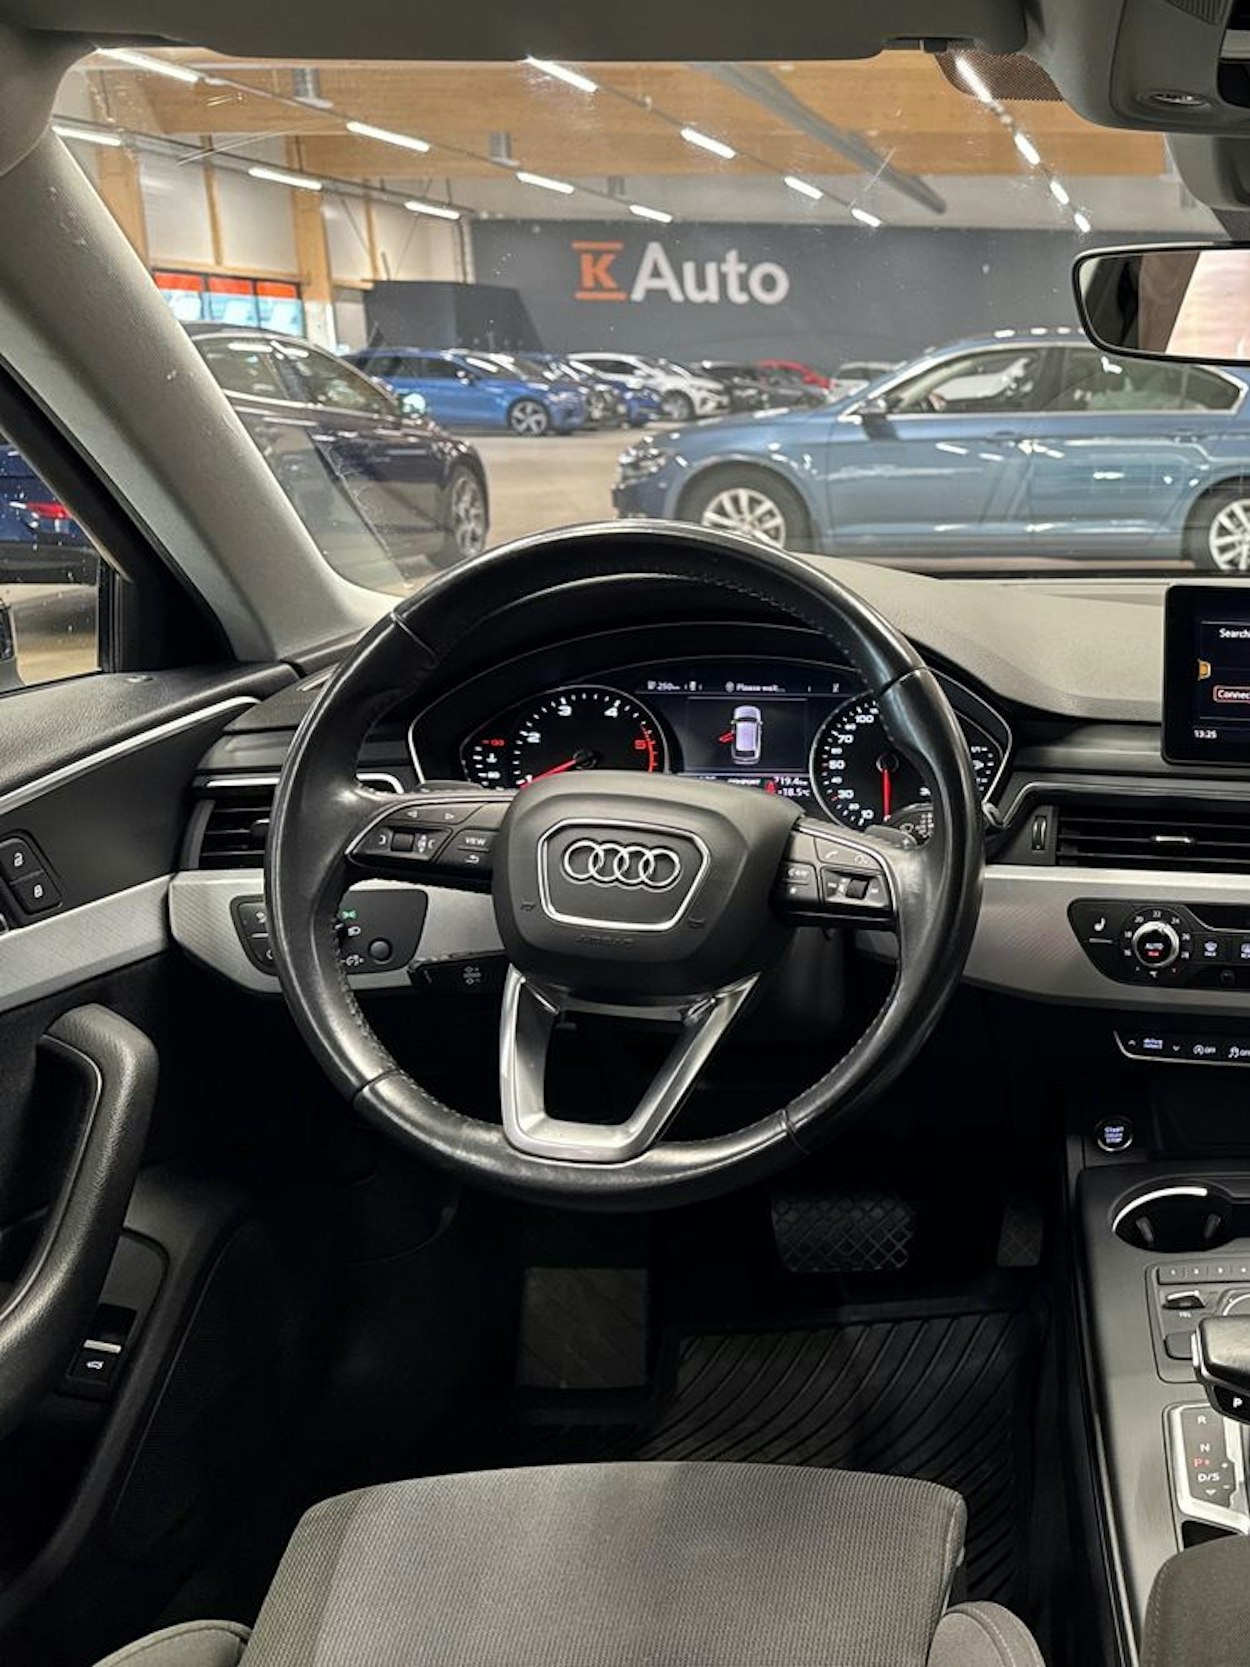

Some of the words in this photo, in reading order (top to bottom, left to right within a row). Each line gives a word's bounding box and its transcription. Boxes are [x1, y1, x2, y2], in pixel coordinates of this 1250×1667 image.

[630, 241, 790, 304] Auto
[736, 683, 760, 691] Please
[558, 705, 572, 716] 3
[604, 707, 618, 718] 4
[855, 714, 874, 723] 100
[526, 731, 541, 743] 2
[838, 734, 854, 743] 70
[861, 809, 874, 819] 10
[465, 836, 487, 846] VIEW
[1145, 942, 1164, 950] AUTO
[1204, 1046, 1217, 1054] OFF
[1233, 1397, 1243, 1408] P
[1198, 1415, 1207, 1424] R
[1200, 1443, 1210, 1452] N
[1194, 1458, 1203, 1468] P
[1198, 1472, 1220, 1482] D/S
